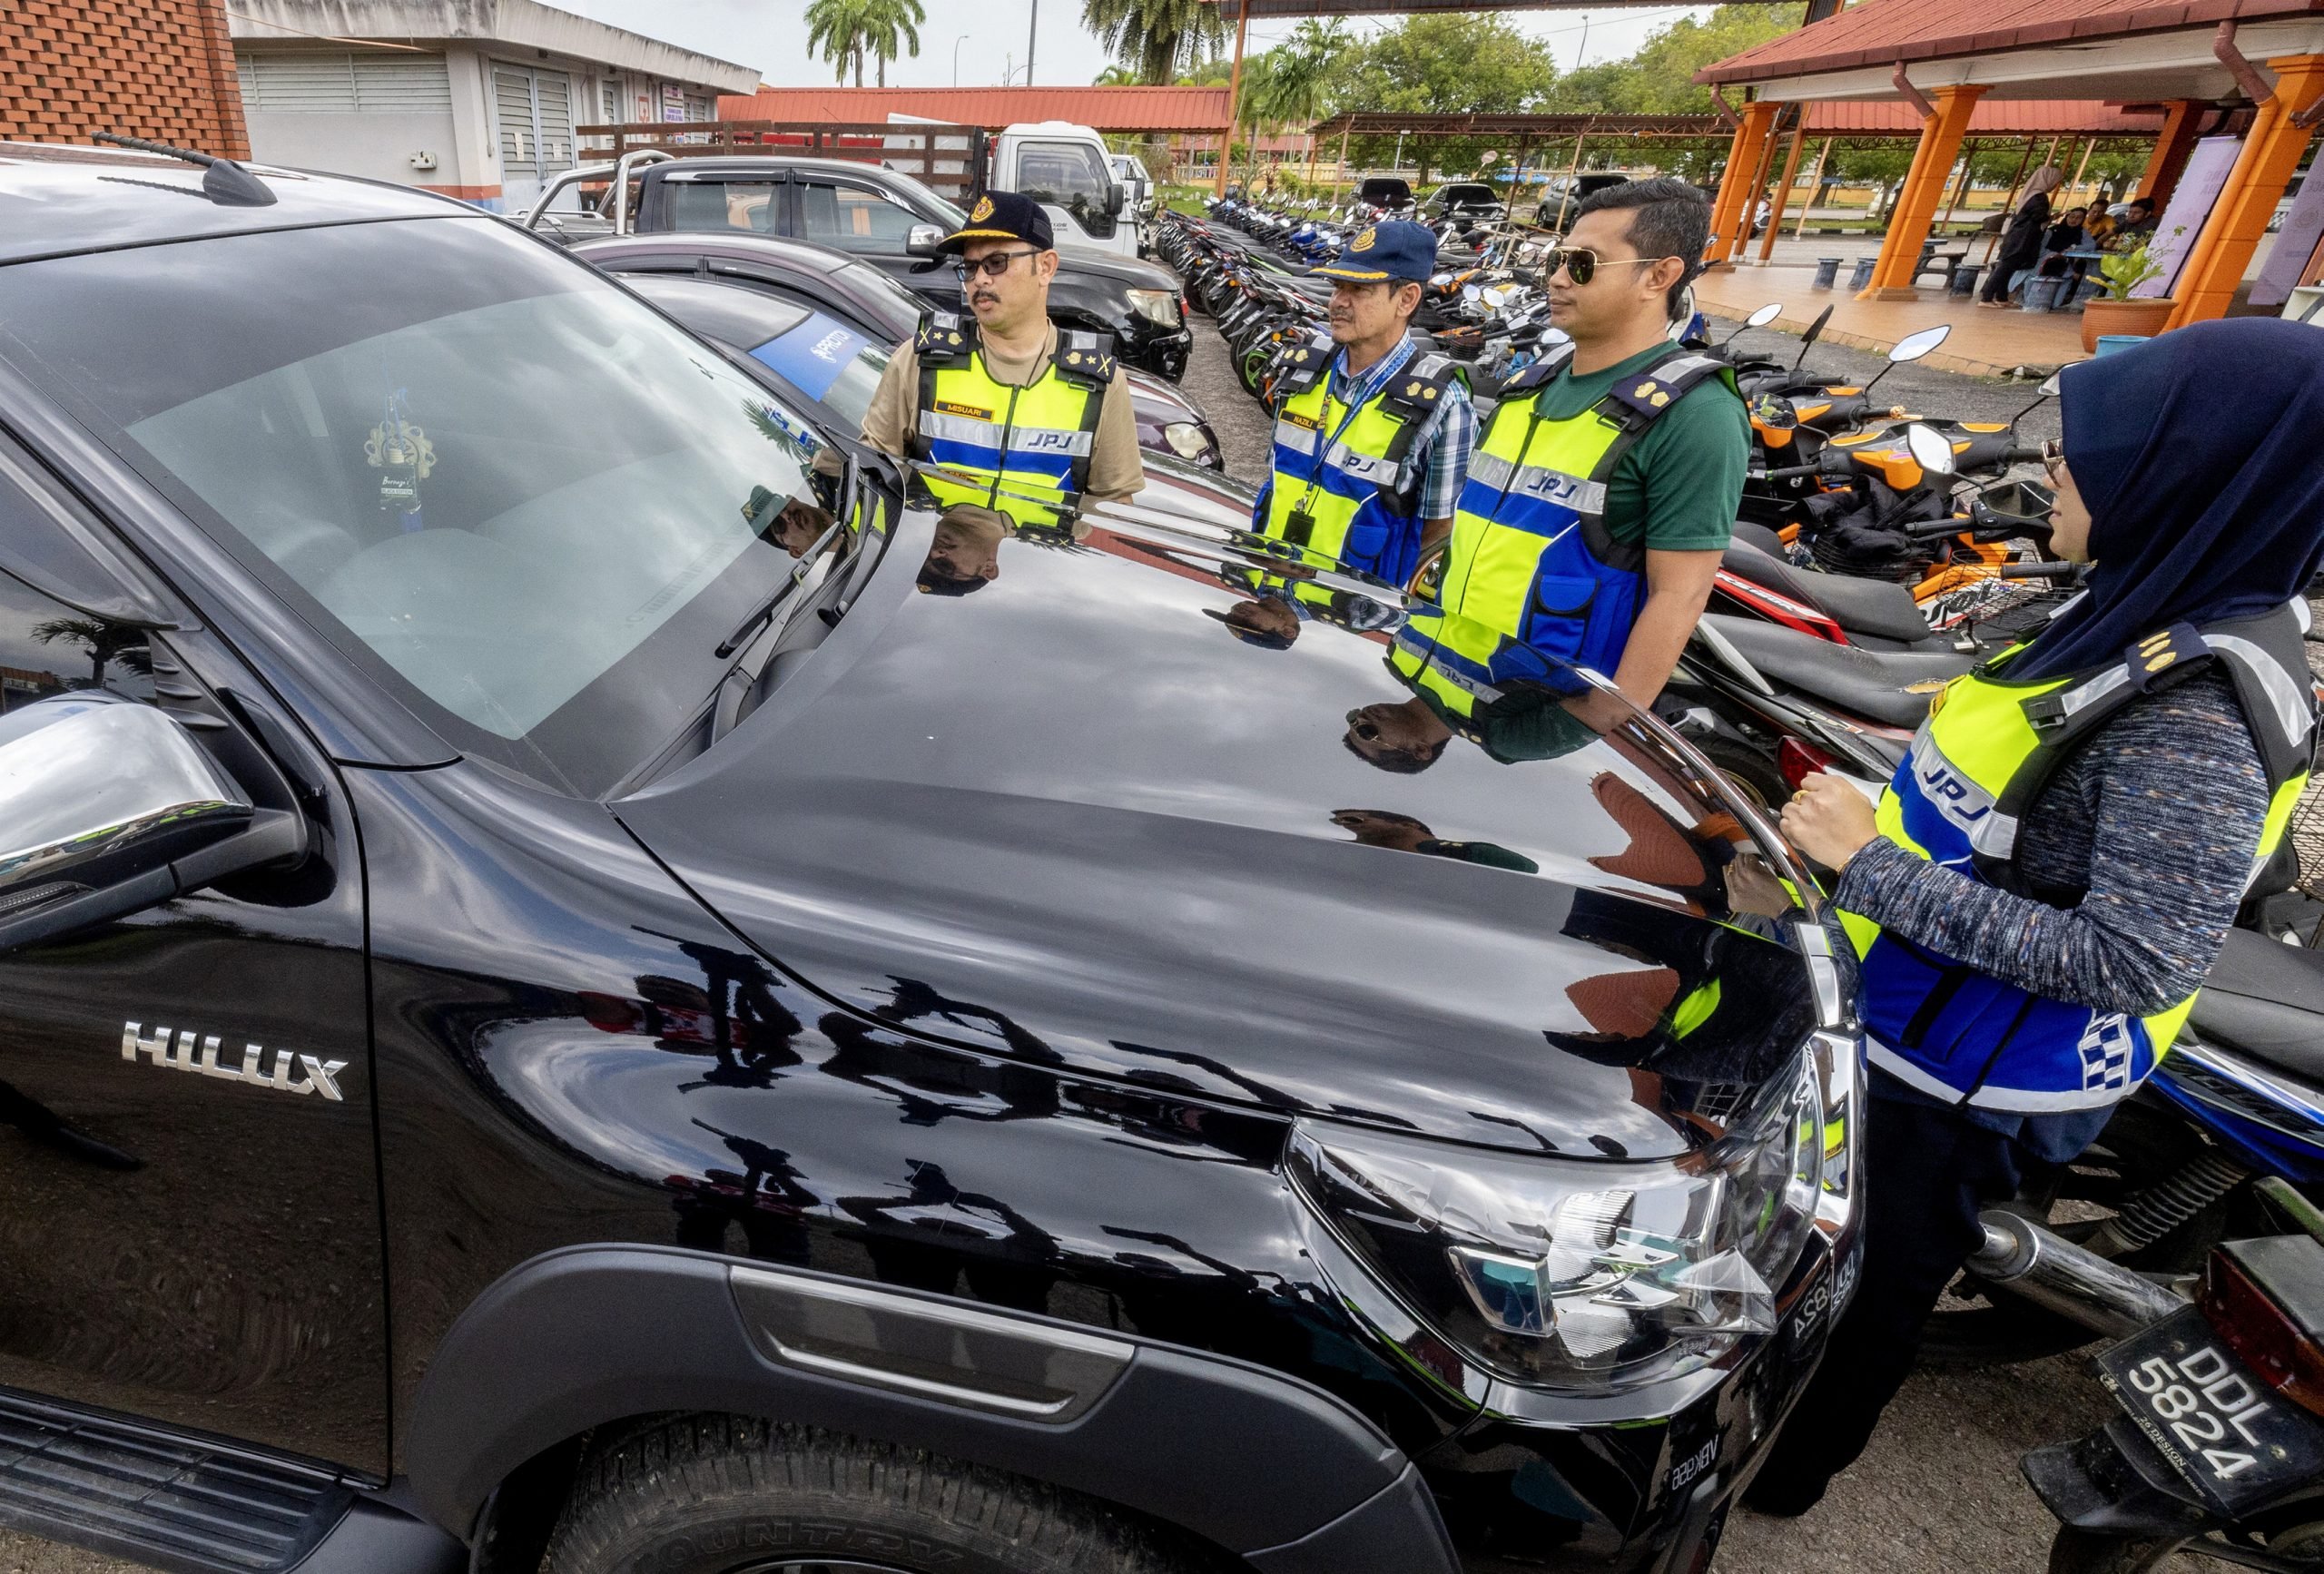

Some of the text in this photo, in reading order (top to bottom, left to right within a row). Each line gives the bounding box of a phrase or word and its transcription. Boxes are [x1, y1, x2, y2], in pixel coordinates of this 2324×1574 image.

[947, 405, 982, 417] MISUARI
[1293, 416, 1314, 428] NAZILI
[1027, 433, 1073, 448] JPJ
[1344, 456, 1375, 473] PJ
[1527, 475, 1578, 498] JPJ
[1923, 768, 1991, 821] JPJ
[121, 1020, 349, 1101] HILUX
[2129, 1356, 2258, 1481] 5824
[2177, 1346, 2271, 1447] DDL
[2139, 1416, 2187, 1468] 26 DESIGN
[634, 1523, 965, 1569] OUNTRY
